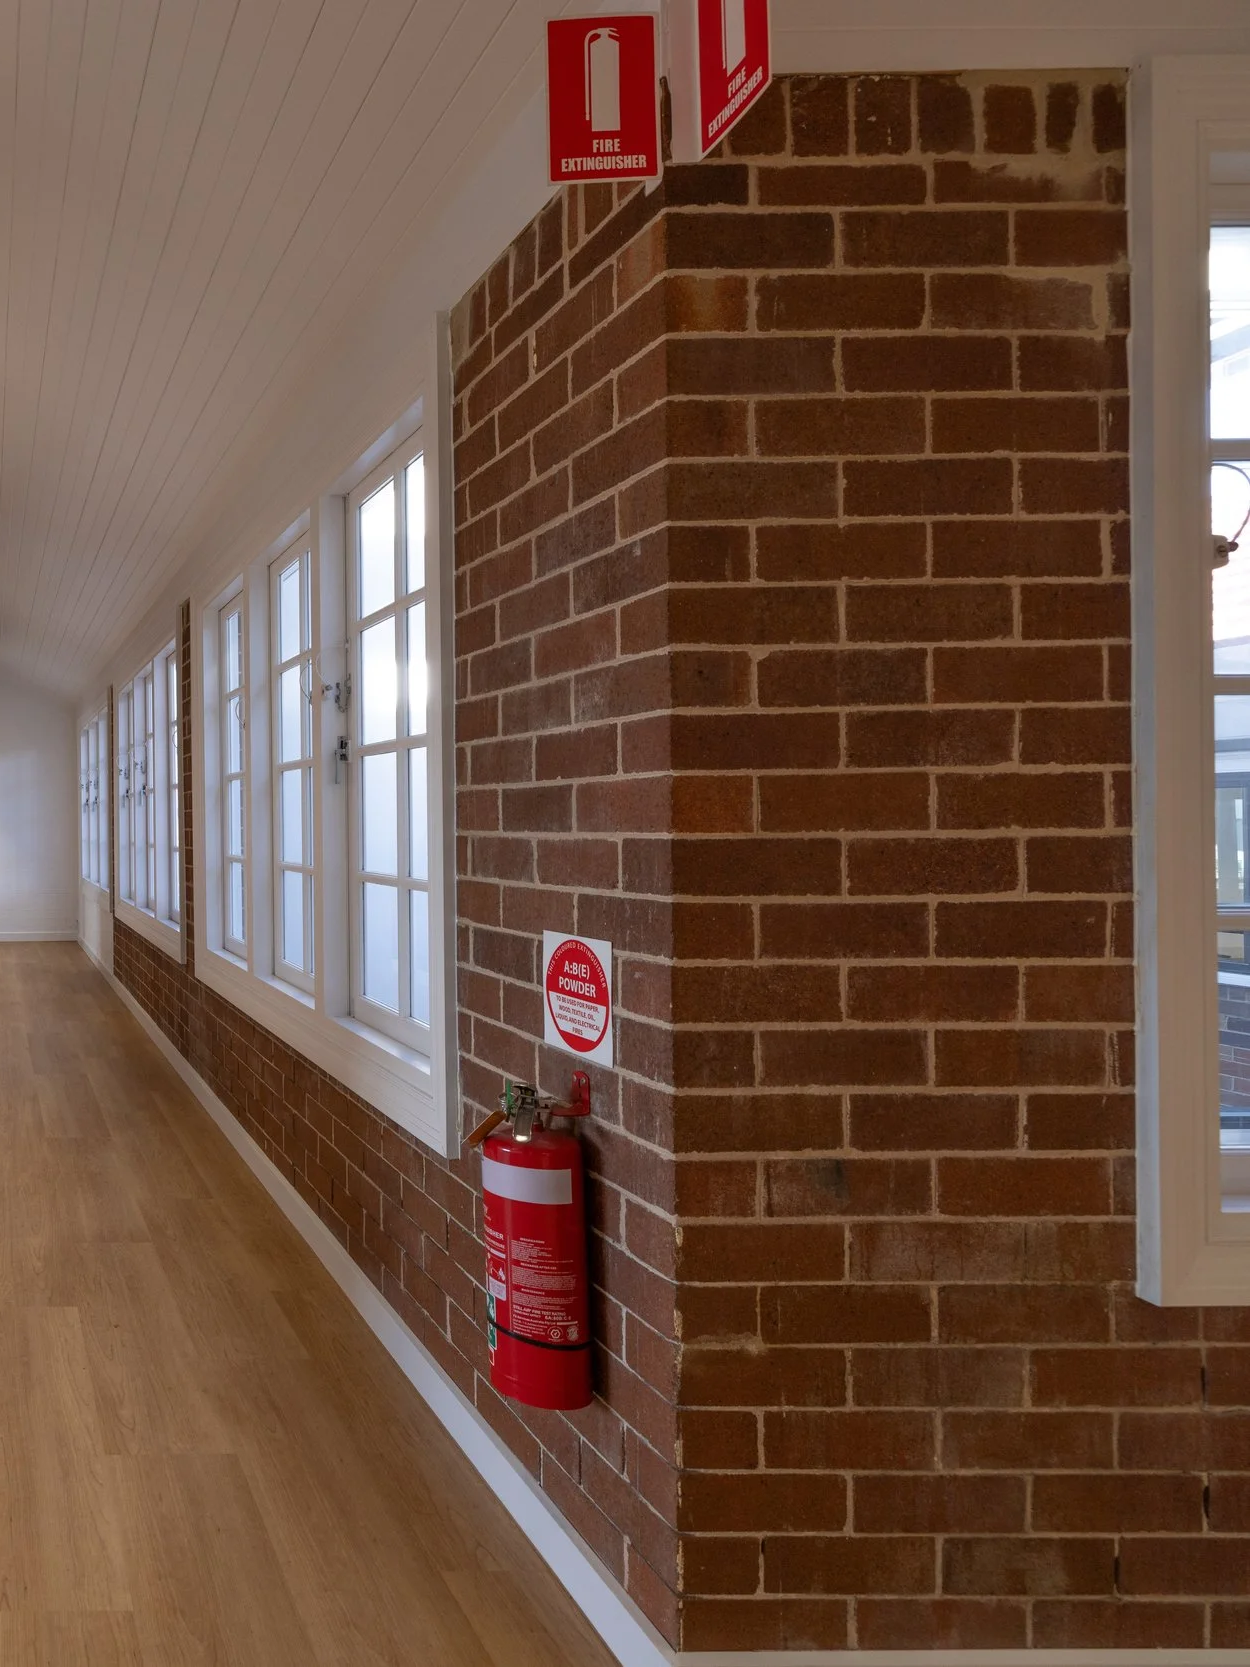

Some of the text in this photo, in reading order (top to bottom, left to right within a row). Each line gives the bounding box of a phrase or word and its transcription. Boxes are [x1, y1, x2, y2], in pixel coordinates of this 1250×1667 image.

[728, 66, 746, 99] FIRE
[708, 66, 763, 138] EXTINGUISHER
[592, 138, 621, 153] FIRE
[561, 154, 647, 172] EXTINGUISHER
[548, 942, 606, 989] THIS COLOURED EXTINGUISHER
[564, 960, 590, 980] A:B(E)
[558, 976, 596, 998] POWDER
[567, 998, 576, 1006] USED
